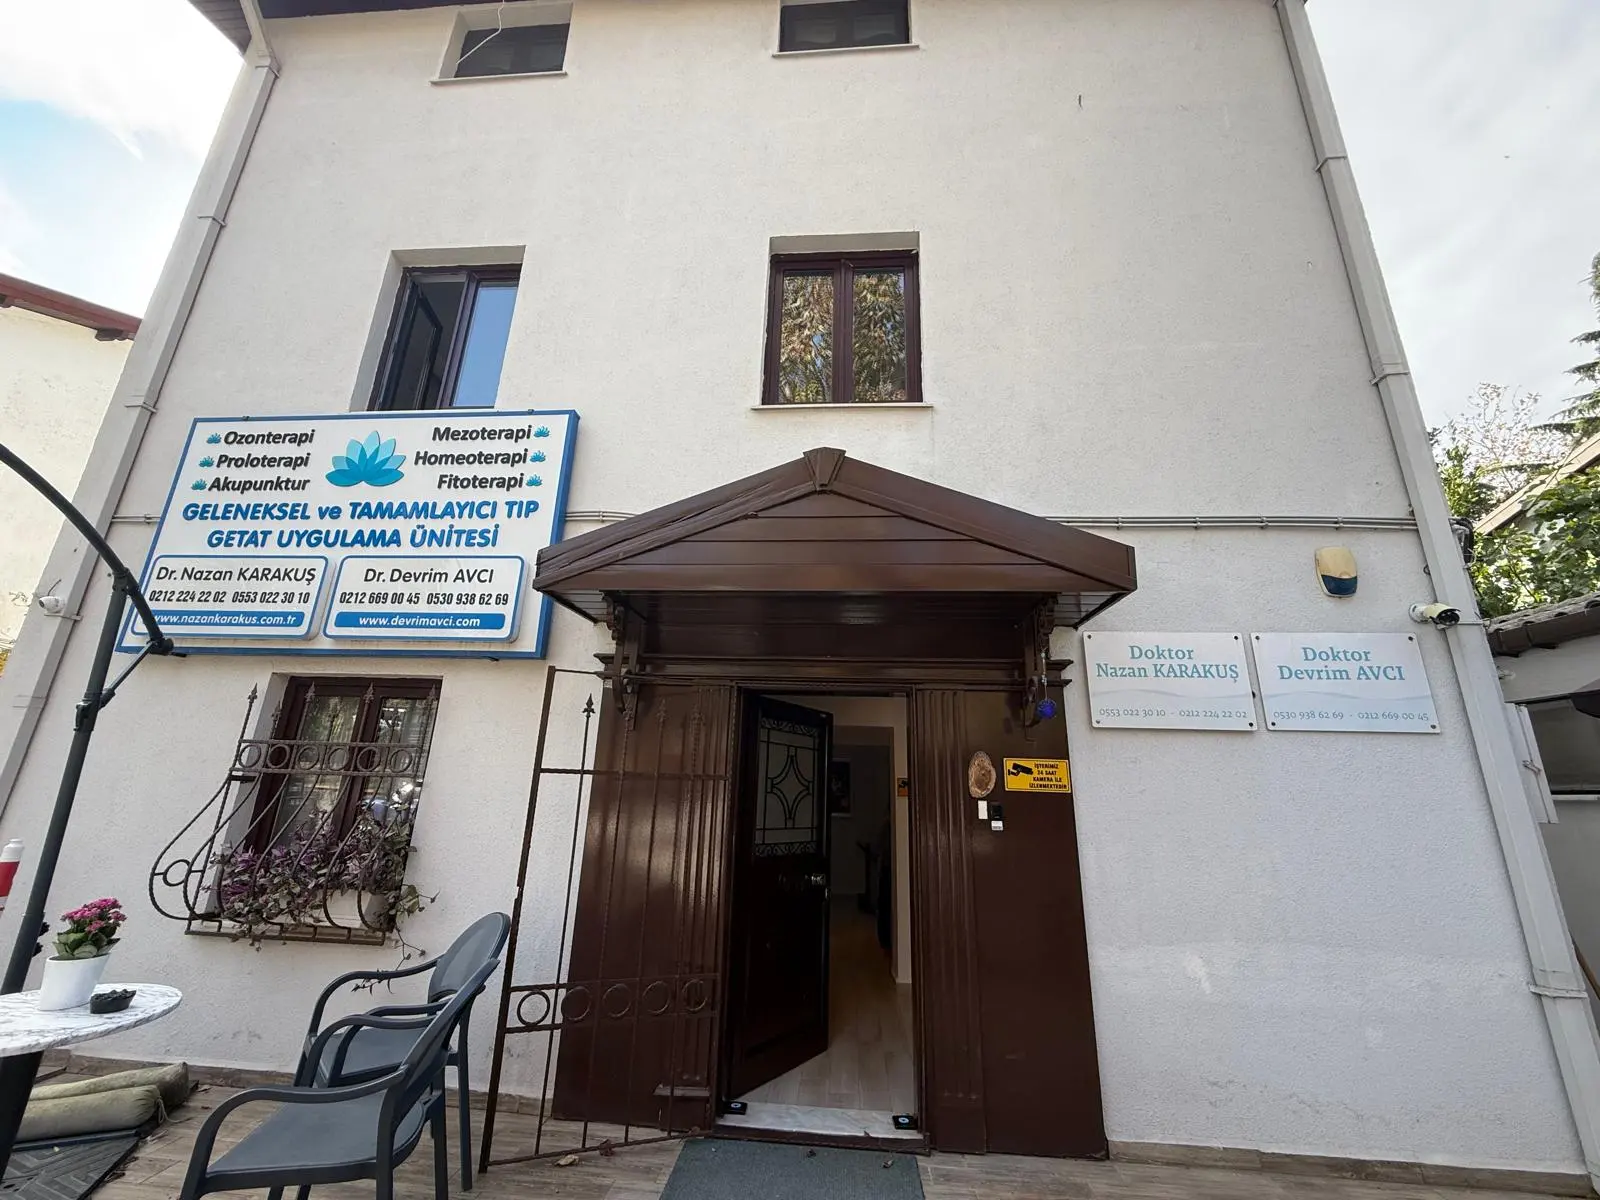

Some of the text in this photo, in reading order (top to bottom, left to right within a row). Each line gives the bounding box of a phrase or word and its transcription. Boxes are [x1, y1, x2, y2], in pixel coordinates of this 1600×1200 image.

[223, 429, 315, 446] Ozonterapi
[432, 425, 532, 442] Mezoterapi
[216, 453, 311, 470] Proloterapi
[414, 448, 528, 467] Homeoterapi
[208, 476, 310, 494] Akupunktur
[437, 473, 524, 491] Fitoterapi
[182, 501, 539, 520] GELENEKSEL ve TAMAMLAYICI TIP
[207, 524, 499, 548] GETAT UYGULAMA ÜNİTESİ
[156, 567, 316, 585] Dr. Nazan KARAKUŞ
[364, 568, 494, 583] Dr. Devrim AVCI
[149, 590, 226, 602] 0212 224 22 02
[232, 591, 310, 603] 0553 022 30 10
[339, 592, 420, 604] 0212 669 00 45
[427, 593, 508, 605] 0530 938 62 69
[359, 615, 480, 627] www.devrimavci.com
[1129, 645, 1194, 660] Doktor
[1302, 647, 1371, 662] Doktor
[1096, 663, 1239, 683] Nazan KARAKUŞ
[1277, 665, 1405, 681] Devrim AVCI
[1099, 708, 1120, 717] 0553
[1142, 709, 1155, 717] 30
[1203, 710, 1219, 718] 224
[1222, 710, 1232, 718] 22
[1235, 710, 1247, 718] 02
[1274, 711, 1296, 719] 0530
[1300, 711, 1315, 719] 938
[1332, 711, 1344, 719] 69
[1382, 712, 1398, 720] 669
[1418, 713, 1429, 721] 45
